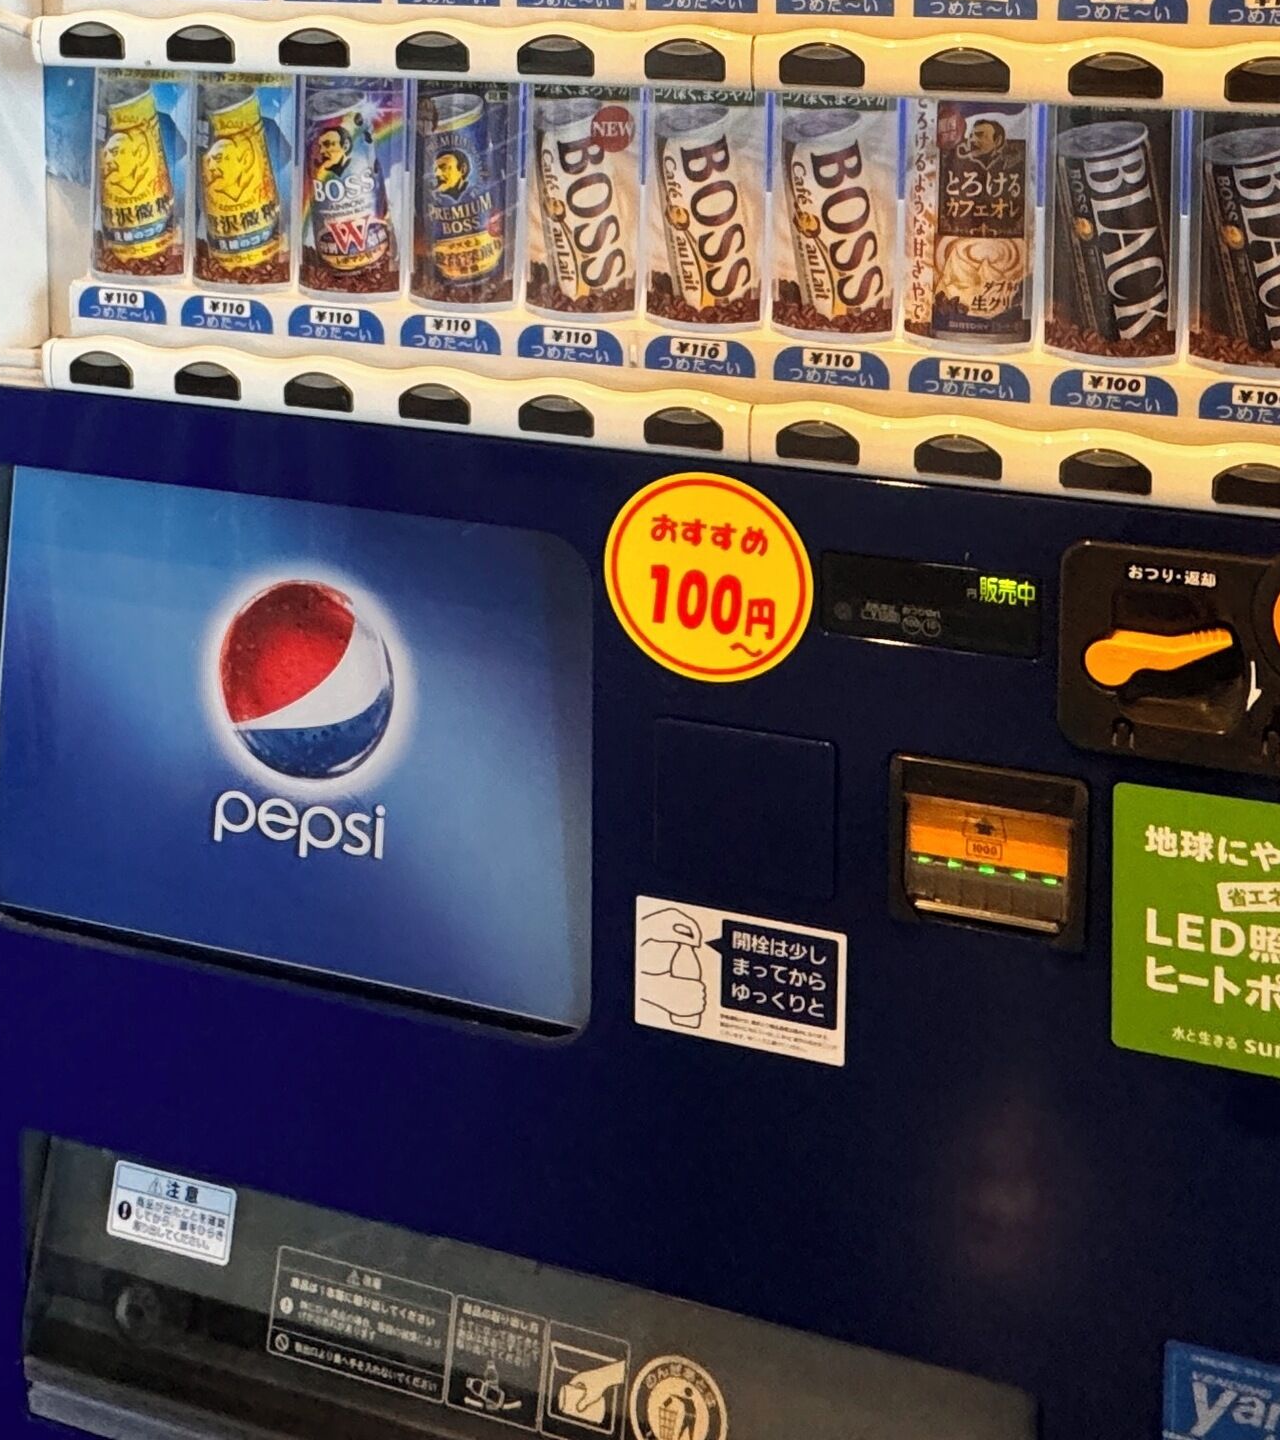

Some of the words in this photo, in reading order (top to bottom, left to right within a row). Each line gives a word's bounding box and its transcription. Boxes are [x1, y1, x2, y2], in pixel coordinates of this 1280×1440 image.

[592, 120, 634, 137] NEW
[313, 169, 374, 202] BOSS
[946, 171, 1020, 197] とろける
[1071, 169, 1088, 214] BOSS
[1218, 175, 1238, 223] BOSS
[428, 192, 492, 222] PREMIUM
[556, 138, 626, 290] BOSS
[680, 136, 751, 298] BOSS
[947, 199, 1019, 219] カフェオレ
[442, 217, 481, 235] BOSS
[810, 140, 884, 308] BOSS
[1084, 145, 1167, 339] BLACK
[315, 310, 353, 326] ¥110
[551, 329, 592, 346] ¥110
[809, 352, 855, 368] ¥110
[1089, 375, 1142, 394] ¥100
[651, 513, 768, 557] おすすめ
[979, 576, 1036, 607] 販売中
[213, 790, 386, 860] pepsi
[732, 930, 827, 965] 開栓は少し
[732, 958, 826, 991] まってから
[731, 982, 825, 1018] ゆっくりと
[1172, 1025, 1237, 1050] 水と生きる
[166, 1179, 198, 1204] 注意
